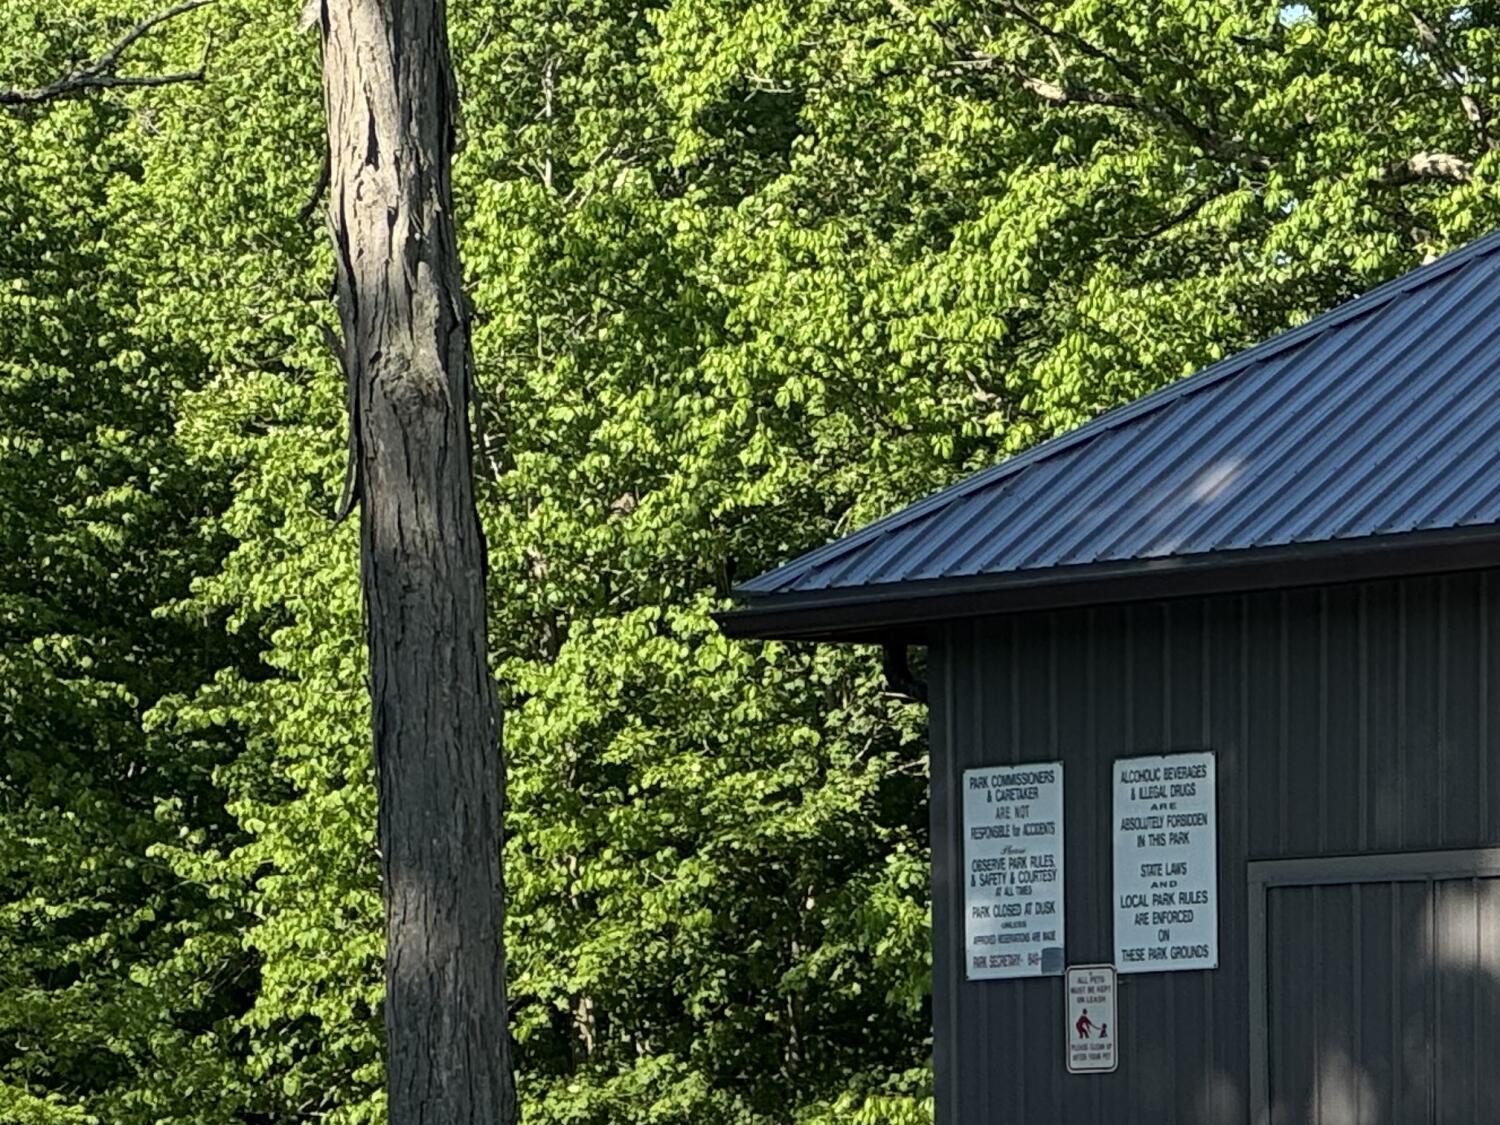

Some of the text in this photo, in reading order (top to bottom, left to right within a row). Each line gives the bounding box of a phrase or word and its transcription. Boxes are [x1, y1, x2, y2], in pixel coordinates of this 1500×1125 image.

[970, 770, 1055, 789] PARK COMMISSIONERS
[1121, 765, 1207, 783] ALCOHOLIC BEVERAGES
[995, 786, 1039, 802] CARETAKER
[1139, 785, 1167, 799] ILLEGAL
[1170, 782, 1196, 797] DRUGS
[996, 805, 1030, 819] ARE NOT
[1151, 803, 1176, 811] ARE
[1121, 813, 1208, 831] ABSOLUTELY FORBIDDEN
[971, 824, 1010, 840] RESPONSIBLE
[1023, 822, 1055, 836] ACCIDENTS
[1137, 831, 1190, 848] IN THIS PARK
[972, 858, 1006, 873] OBSERVE
[1008, 857, 1027, 870] PARK
[1140, 862, 1187, 877] STATE LAWS
[979, 872, 1007, 886] SAFETY
[1018, 869, 1057, 883] COURTESY
[1151, 880, 1178, 888] AND
[1004, 887, 1014, 896] ALL
[1016, 885, 1032, 895] TIMES
[1120, 890, 1208, 908] LOCAL PARK RULES
[972, 901, 1055, 919] PARK CLOSED AT DUSK
[1135, 910, 1194, 925] ARE ENFORCED
[1158, 929, 1170, 942] ON
[1121, 944, 1209, 962] THESE PARK GROUNDS
